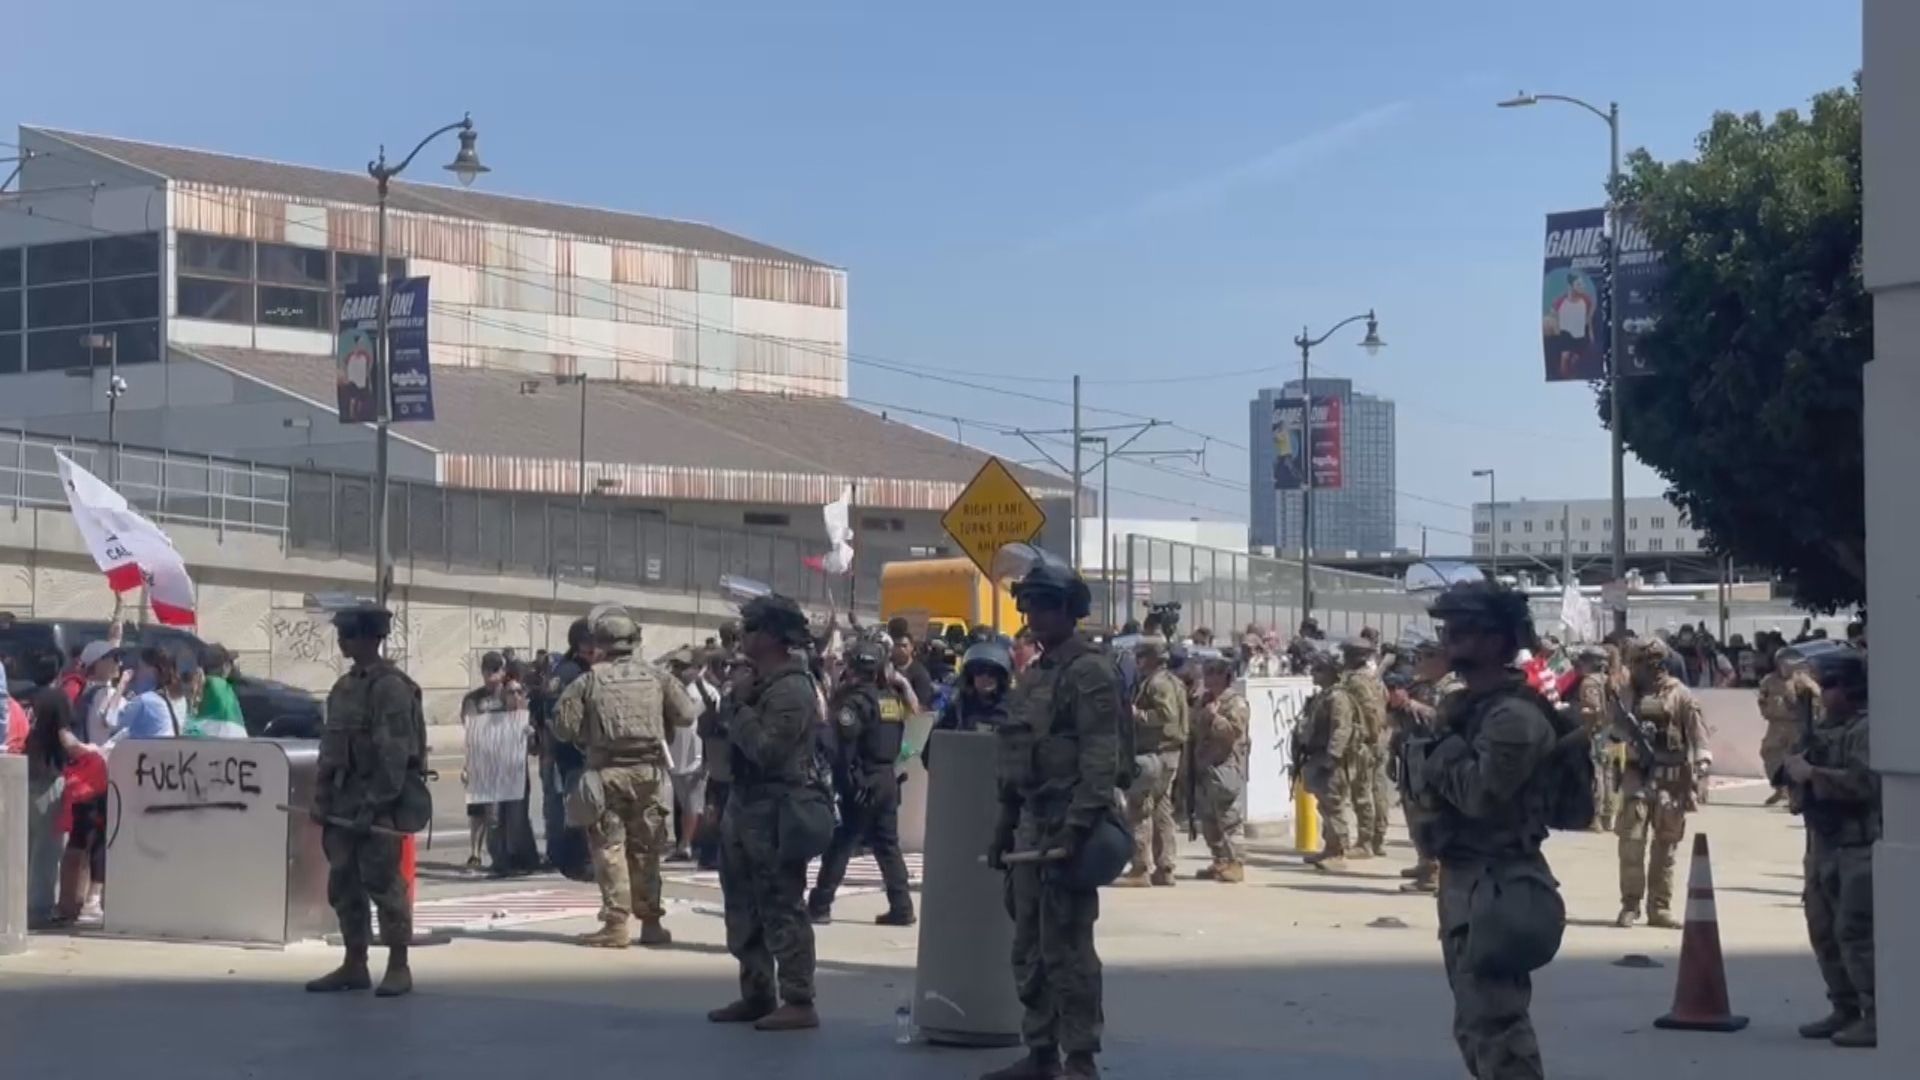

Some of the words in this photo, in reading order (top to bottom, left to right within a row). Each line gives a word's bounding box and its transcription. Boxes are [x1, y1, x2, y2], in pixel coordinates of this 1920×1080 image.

[1546, 227, 1604, 258] GAME
[340, 295, 379, 321] GAME
[389, 292, 415, 317] ON!
[963, 503, 993, 516] RIGHT
[997, 503, 1025, 516] LANE
[960, 521, 993, 535] TURNS
[997, 520, 1028, 535] RIGHT
[208, 756, 261, 796] ICE
